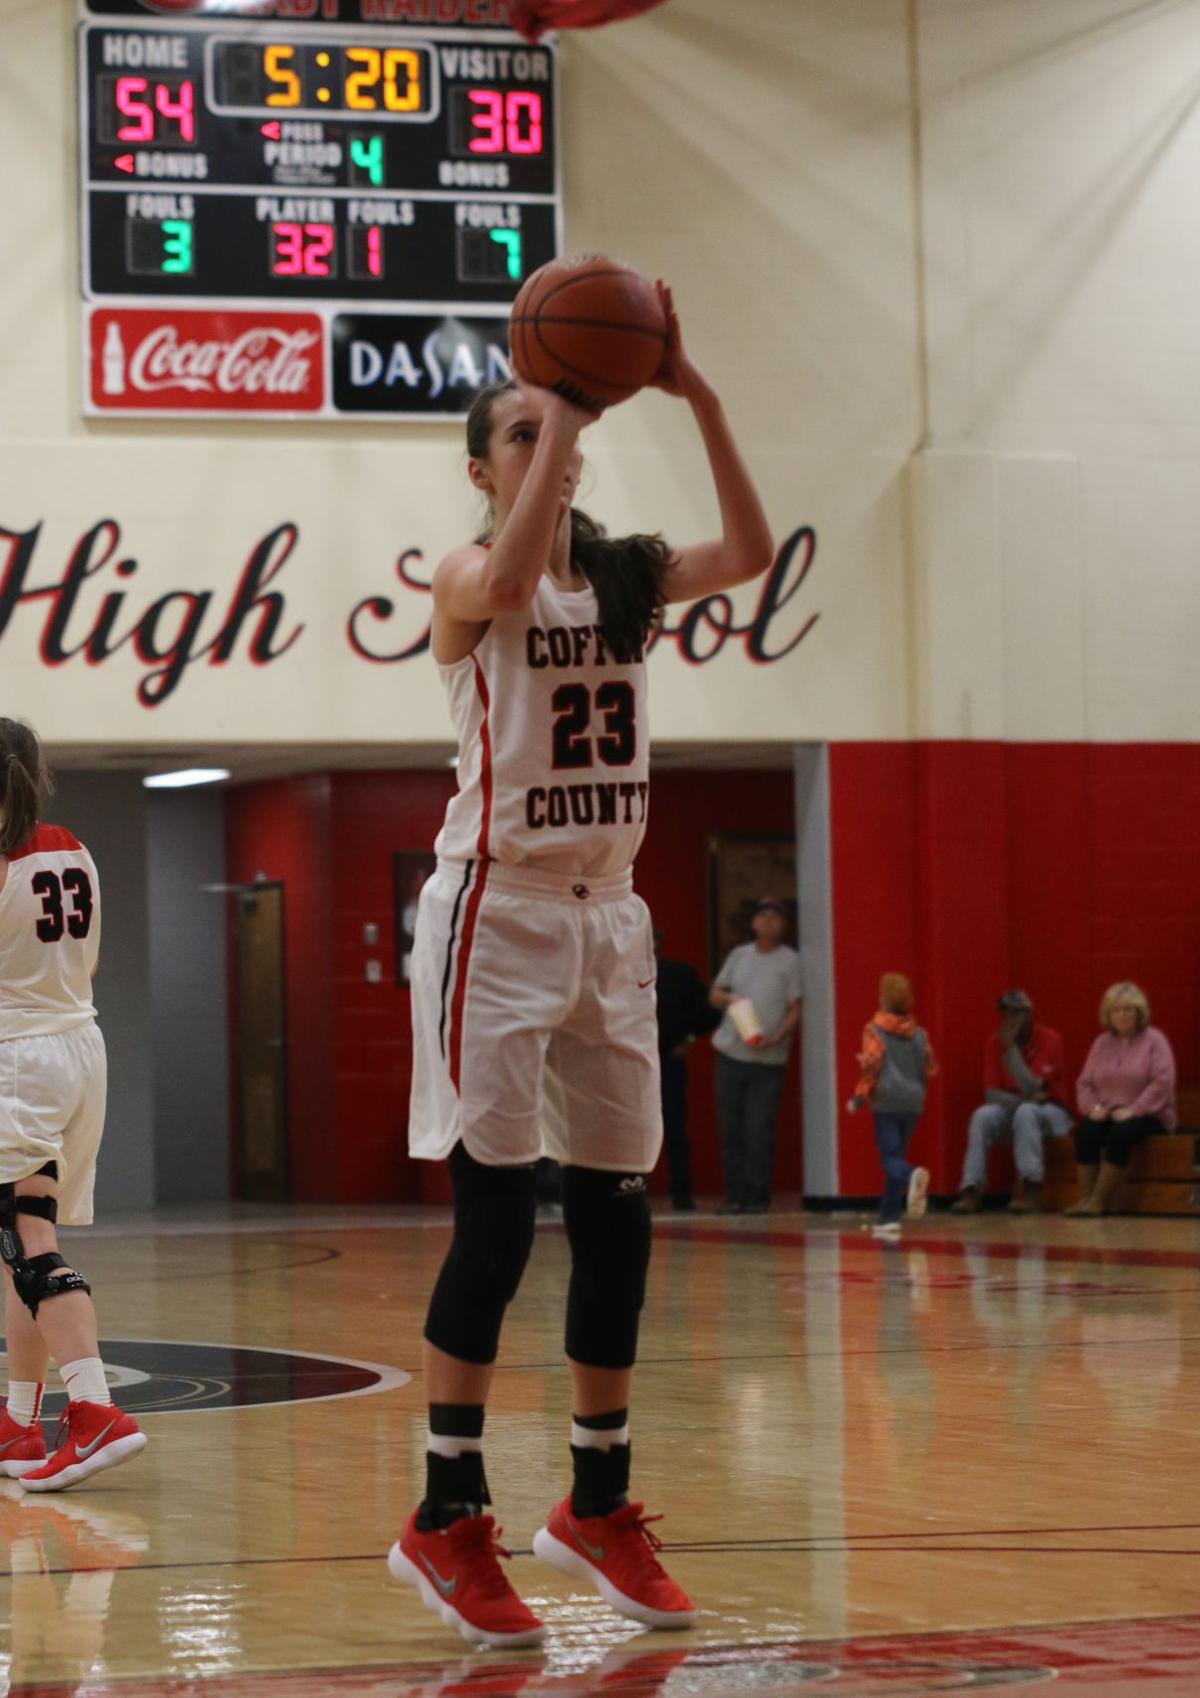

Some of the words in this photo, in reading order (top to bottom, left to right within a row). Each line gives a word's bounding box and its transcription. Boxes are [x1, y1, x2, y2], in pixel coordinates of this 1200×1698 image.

[103, 35, 188, 67] HOME
[441, 49, 549, 80] VISITOR
[264, 45, 420, 111] 5:20
[115, 77, 194, 142] 54
[467, 89, 543, 154] 30
[135, 152, 208, 178] BONUS
[264, 142, 342, 167] PERIOD
[351, 136, 383, 186] 4
[438, 160, 510, 187] BONUS
[126, 195, 195, 219] FOULS
[256, 197, 335, 223] PLAYER
[348, 200, 415, 226] FOULS
[455, 203, 521, 227] FOULS
[161, 219, 192, 274] 3
[272, 222, 334, 276] 32
[366, 226, 381, 277] 1
[489, 229, 522, 279] 7
[129, 325, 320, 393] Coca-Cola
[350, 329, 513, 398] DASAN
[0, 518, 306, 710] High
[346, 525, 820, 667] Sol
[551, 680, 637, 770] 23
[526, 782, 648, 829] COUNTY
[31, 867, 93, 943] 33
